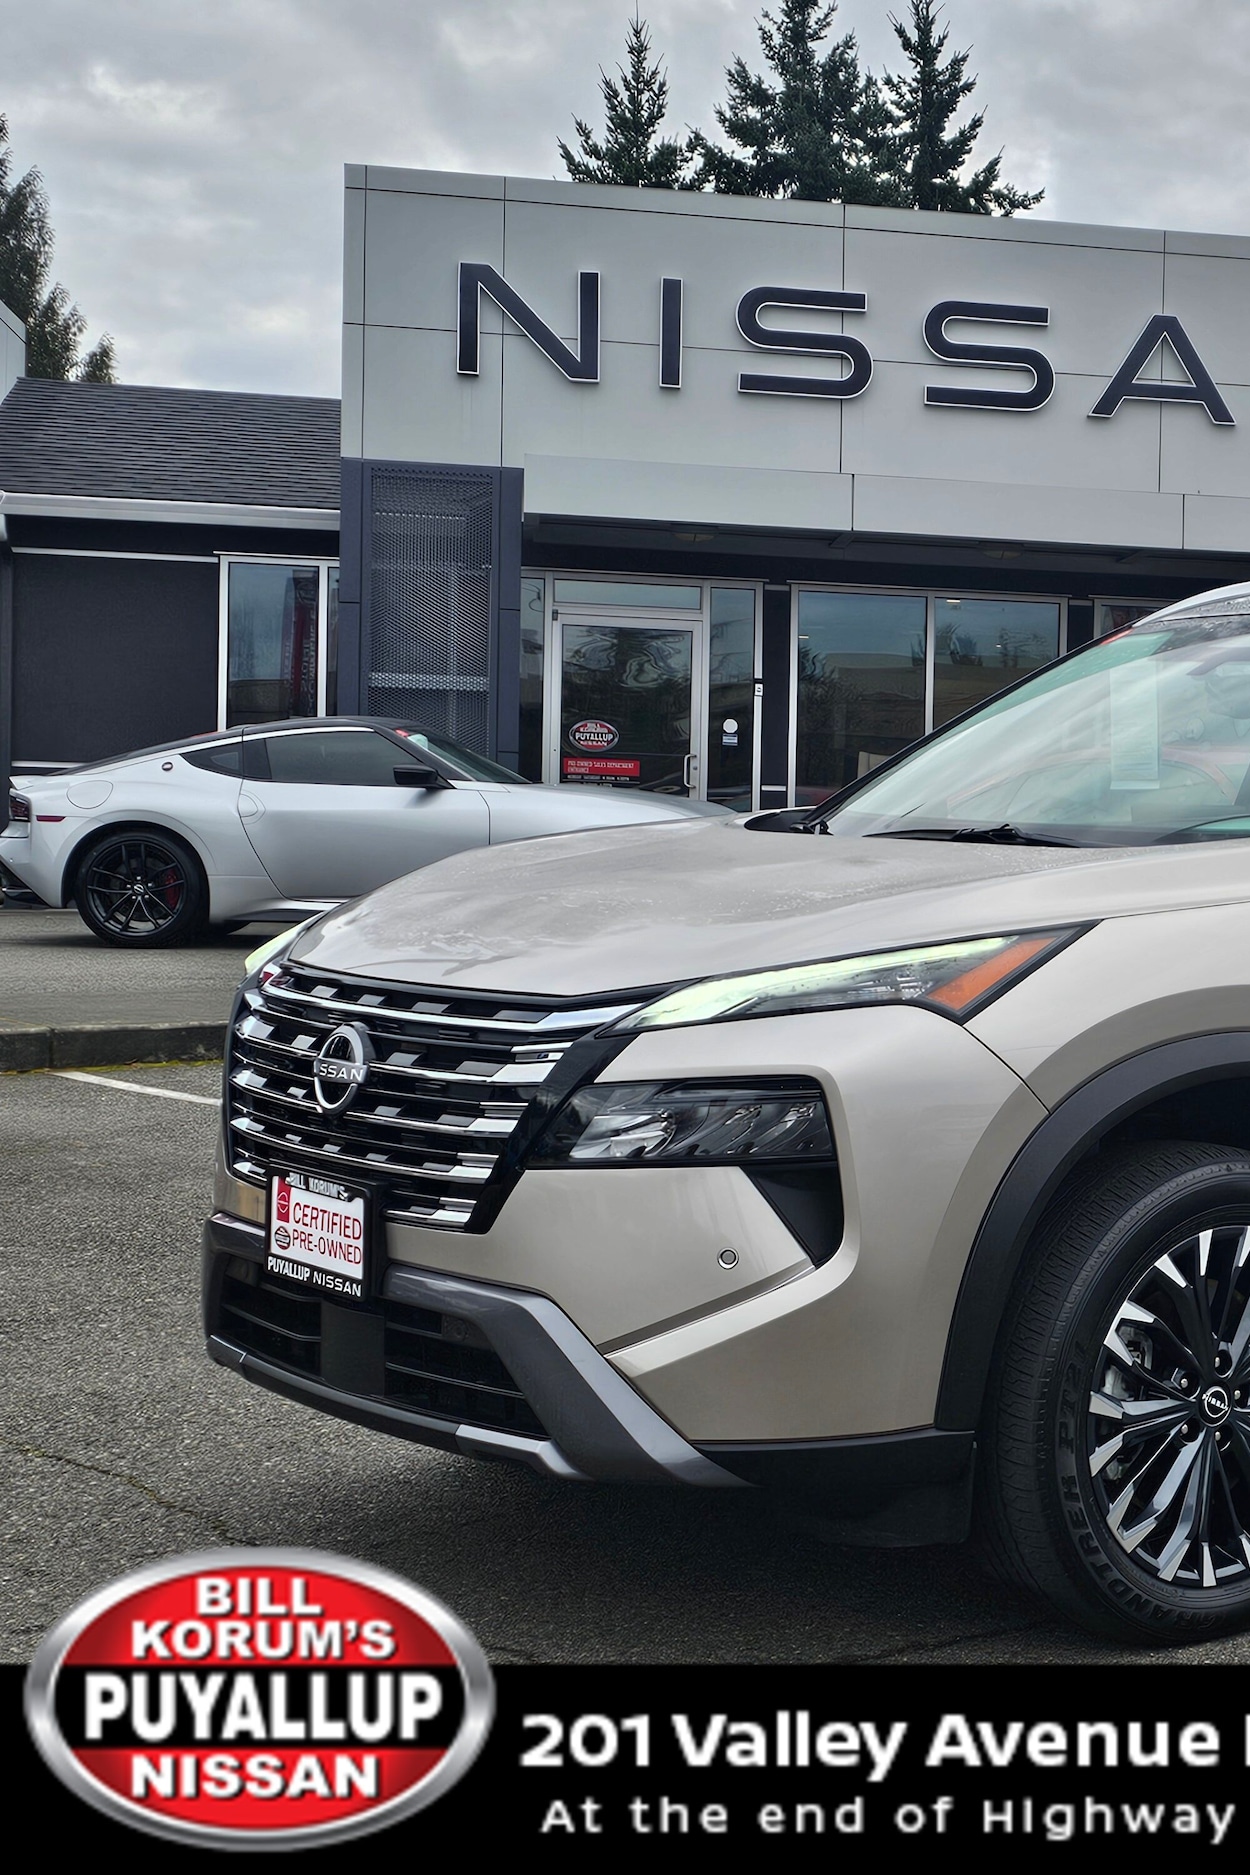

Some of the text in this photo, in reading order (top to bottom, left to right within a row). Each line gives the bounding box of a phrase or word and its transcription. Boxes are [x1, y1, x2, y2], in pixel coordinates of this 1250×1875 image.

[293, 1202, 362, 1241] CERTIFIED
[292, 1228, 362, 1265] PRE-OWNED
[267, 1256, 362, 1297] PUYALLUP NISSAN
